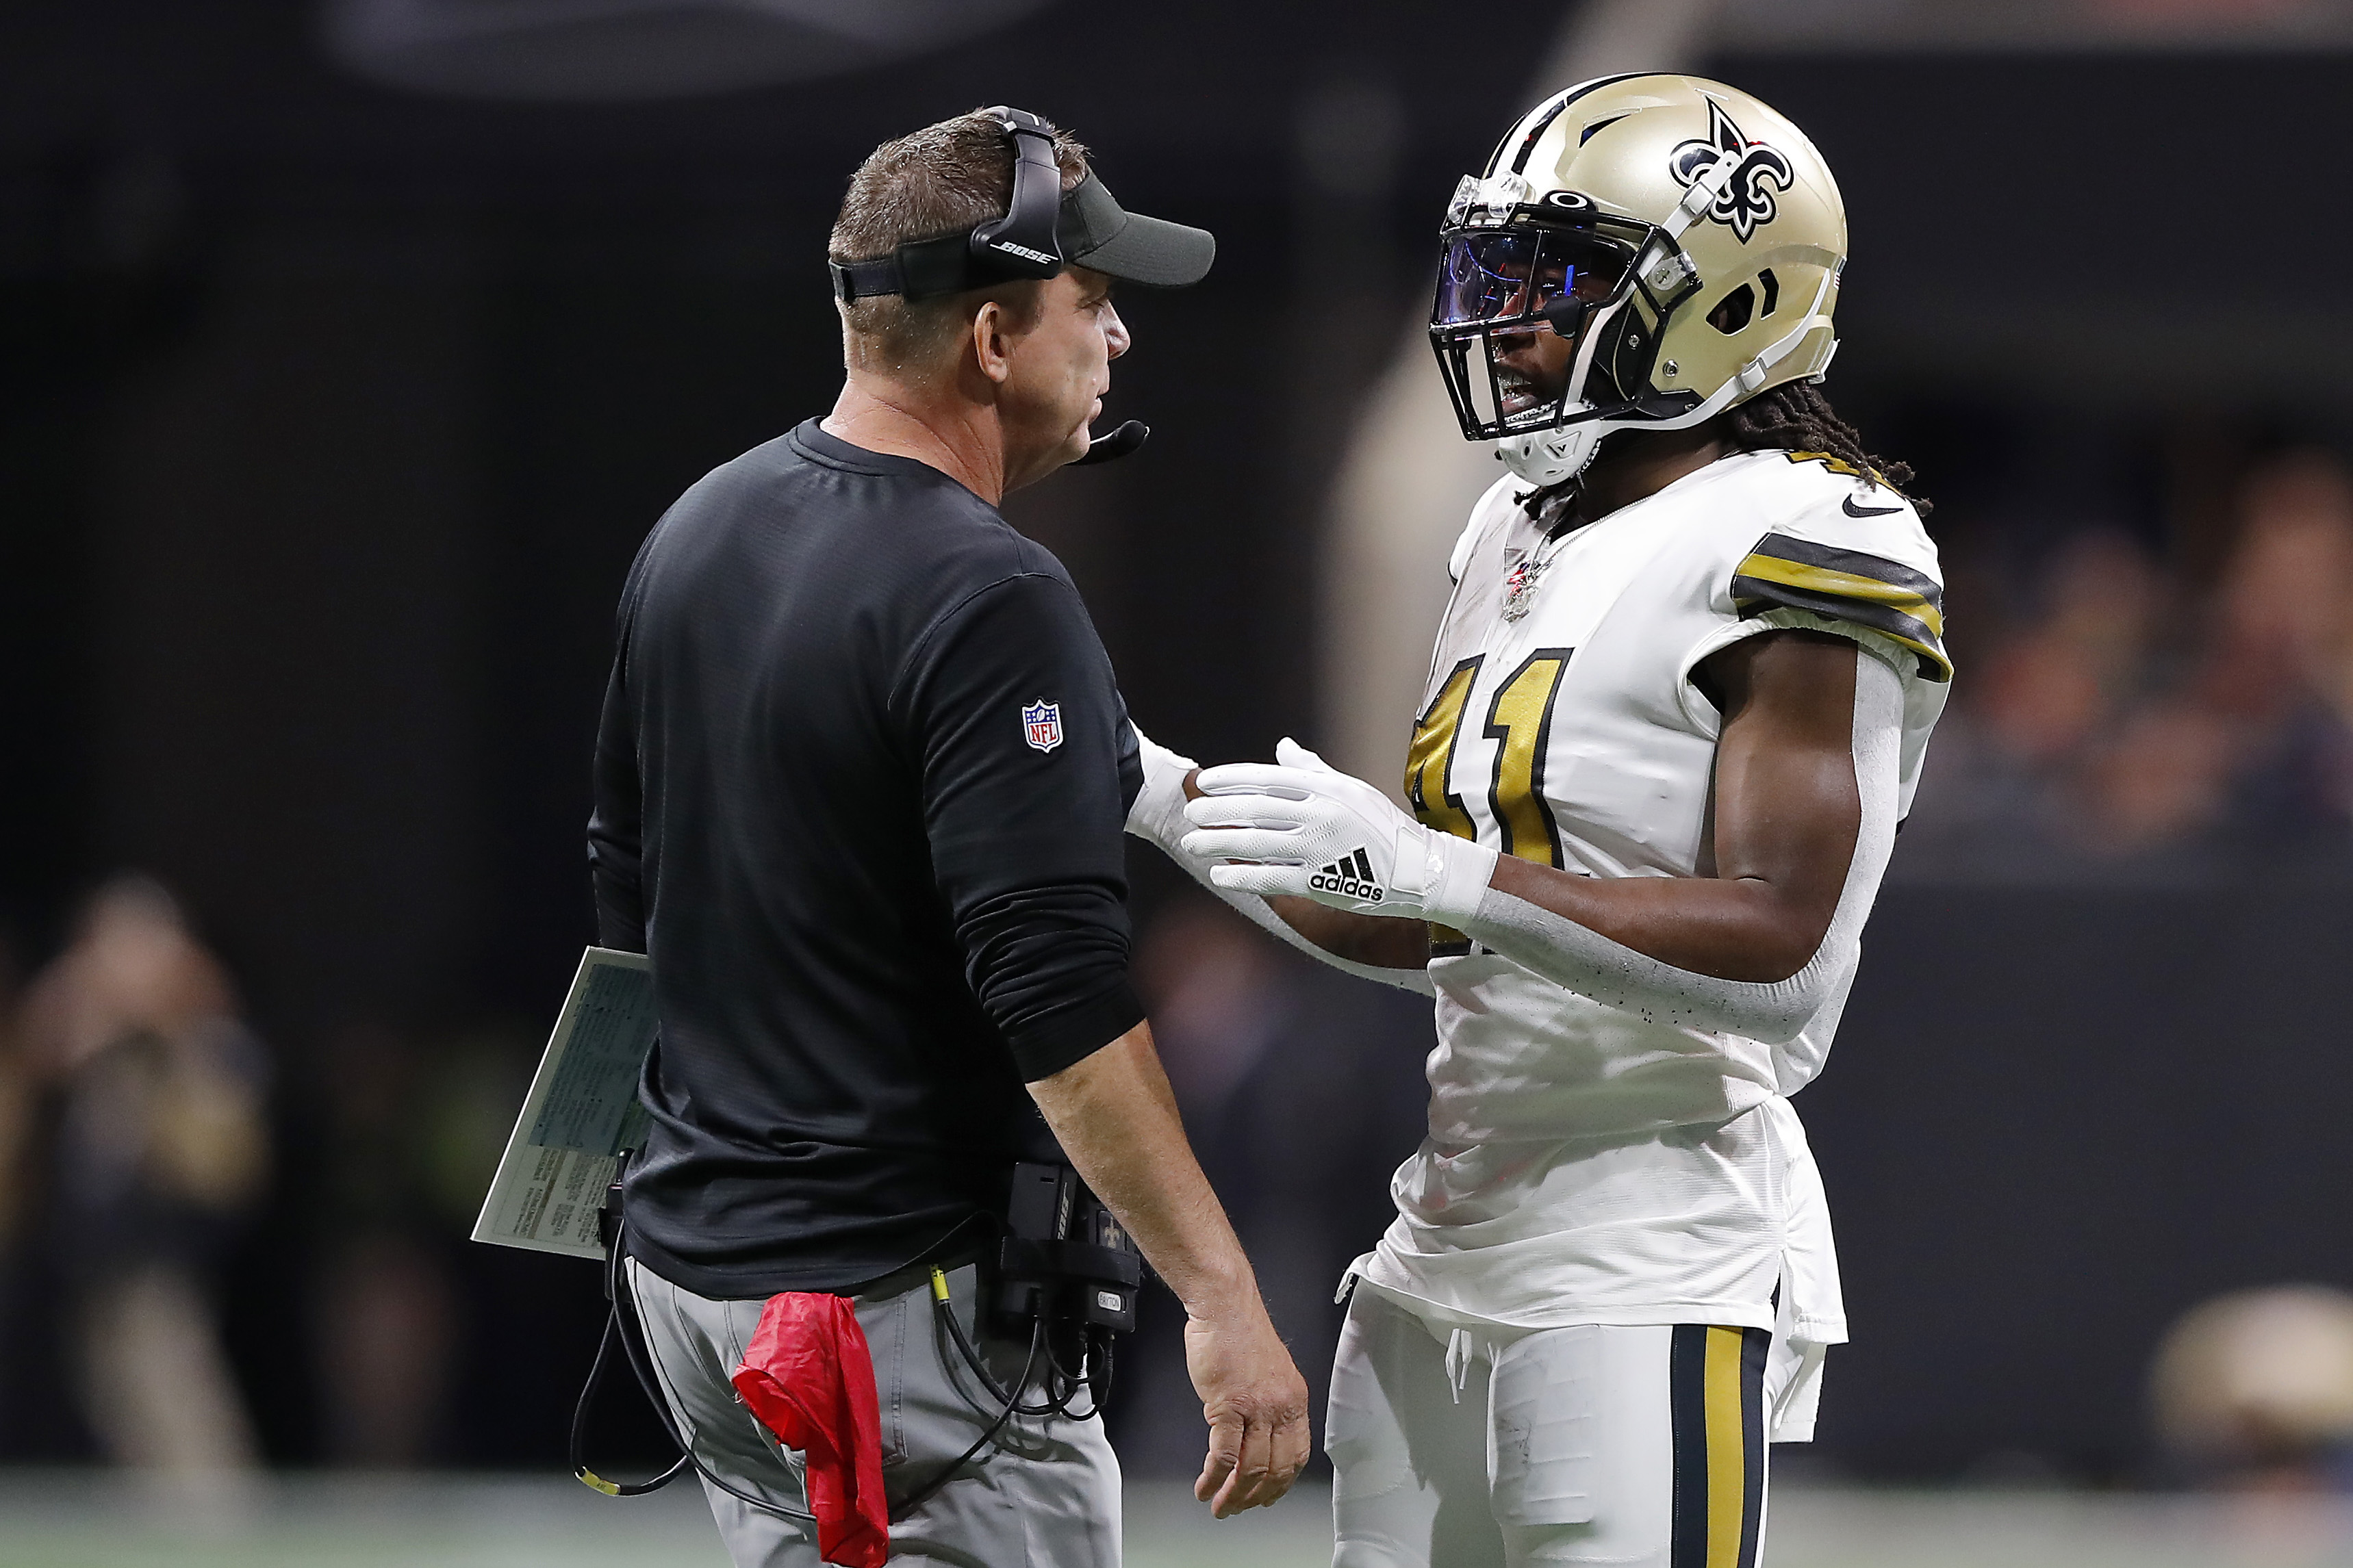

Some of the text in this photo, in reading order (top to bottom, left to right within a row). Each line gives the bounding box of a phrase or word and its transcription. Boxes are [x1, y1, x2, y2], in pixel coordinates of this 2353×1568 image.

[990, 241, 1058, 264] BOSE
[1030, 723, 1056, 743] NFL
[1403, 647, 1580, 956] 41
[1310, 875, 1383, 901] adidas
